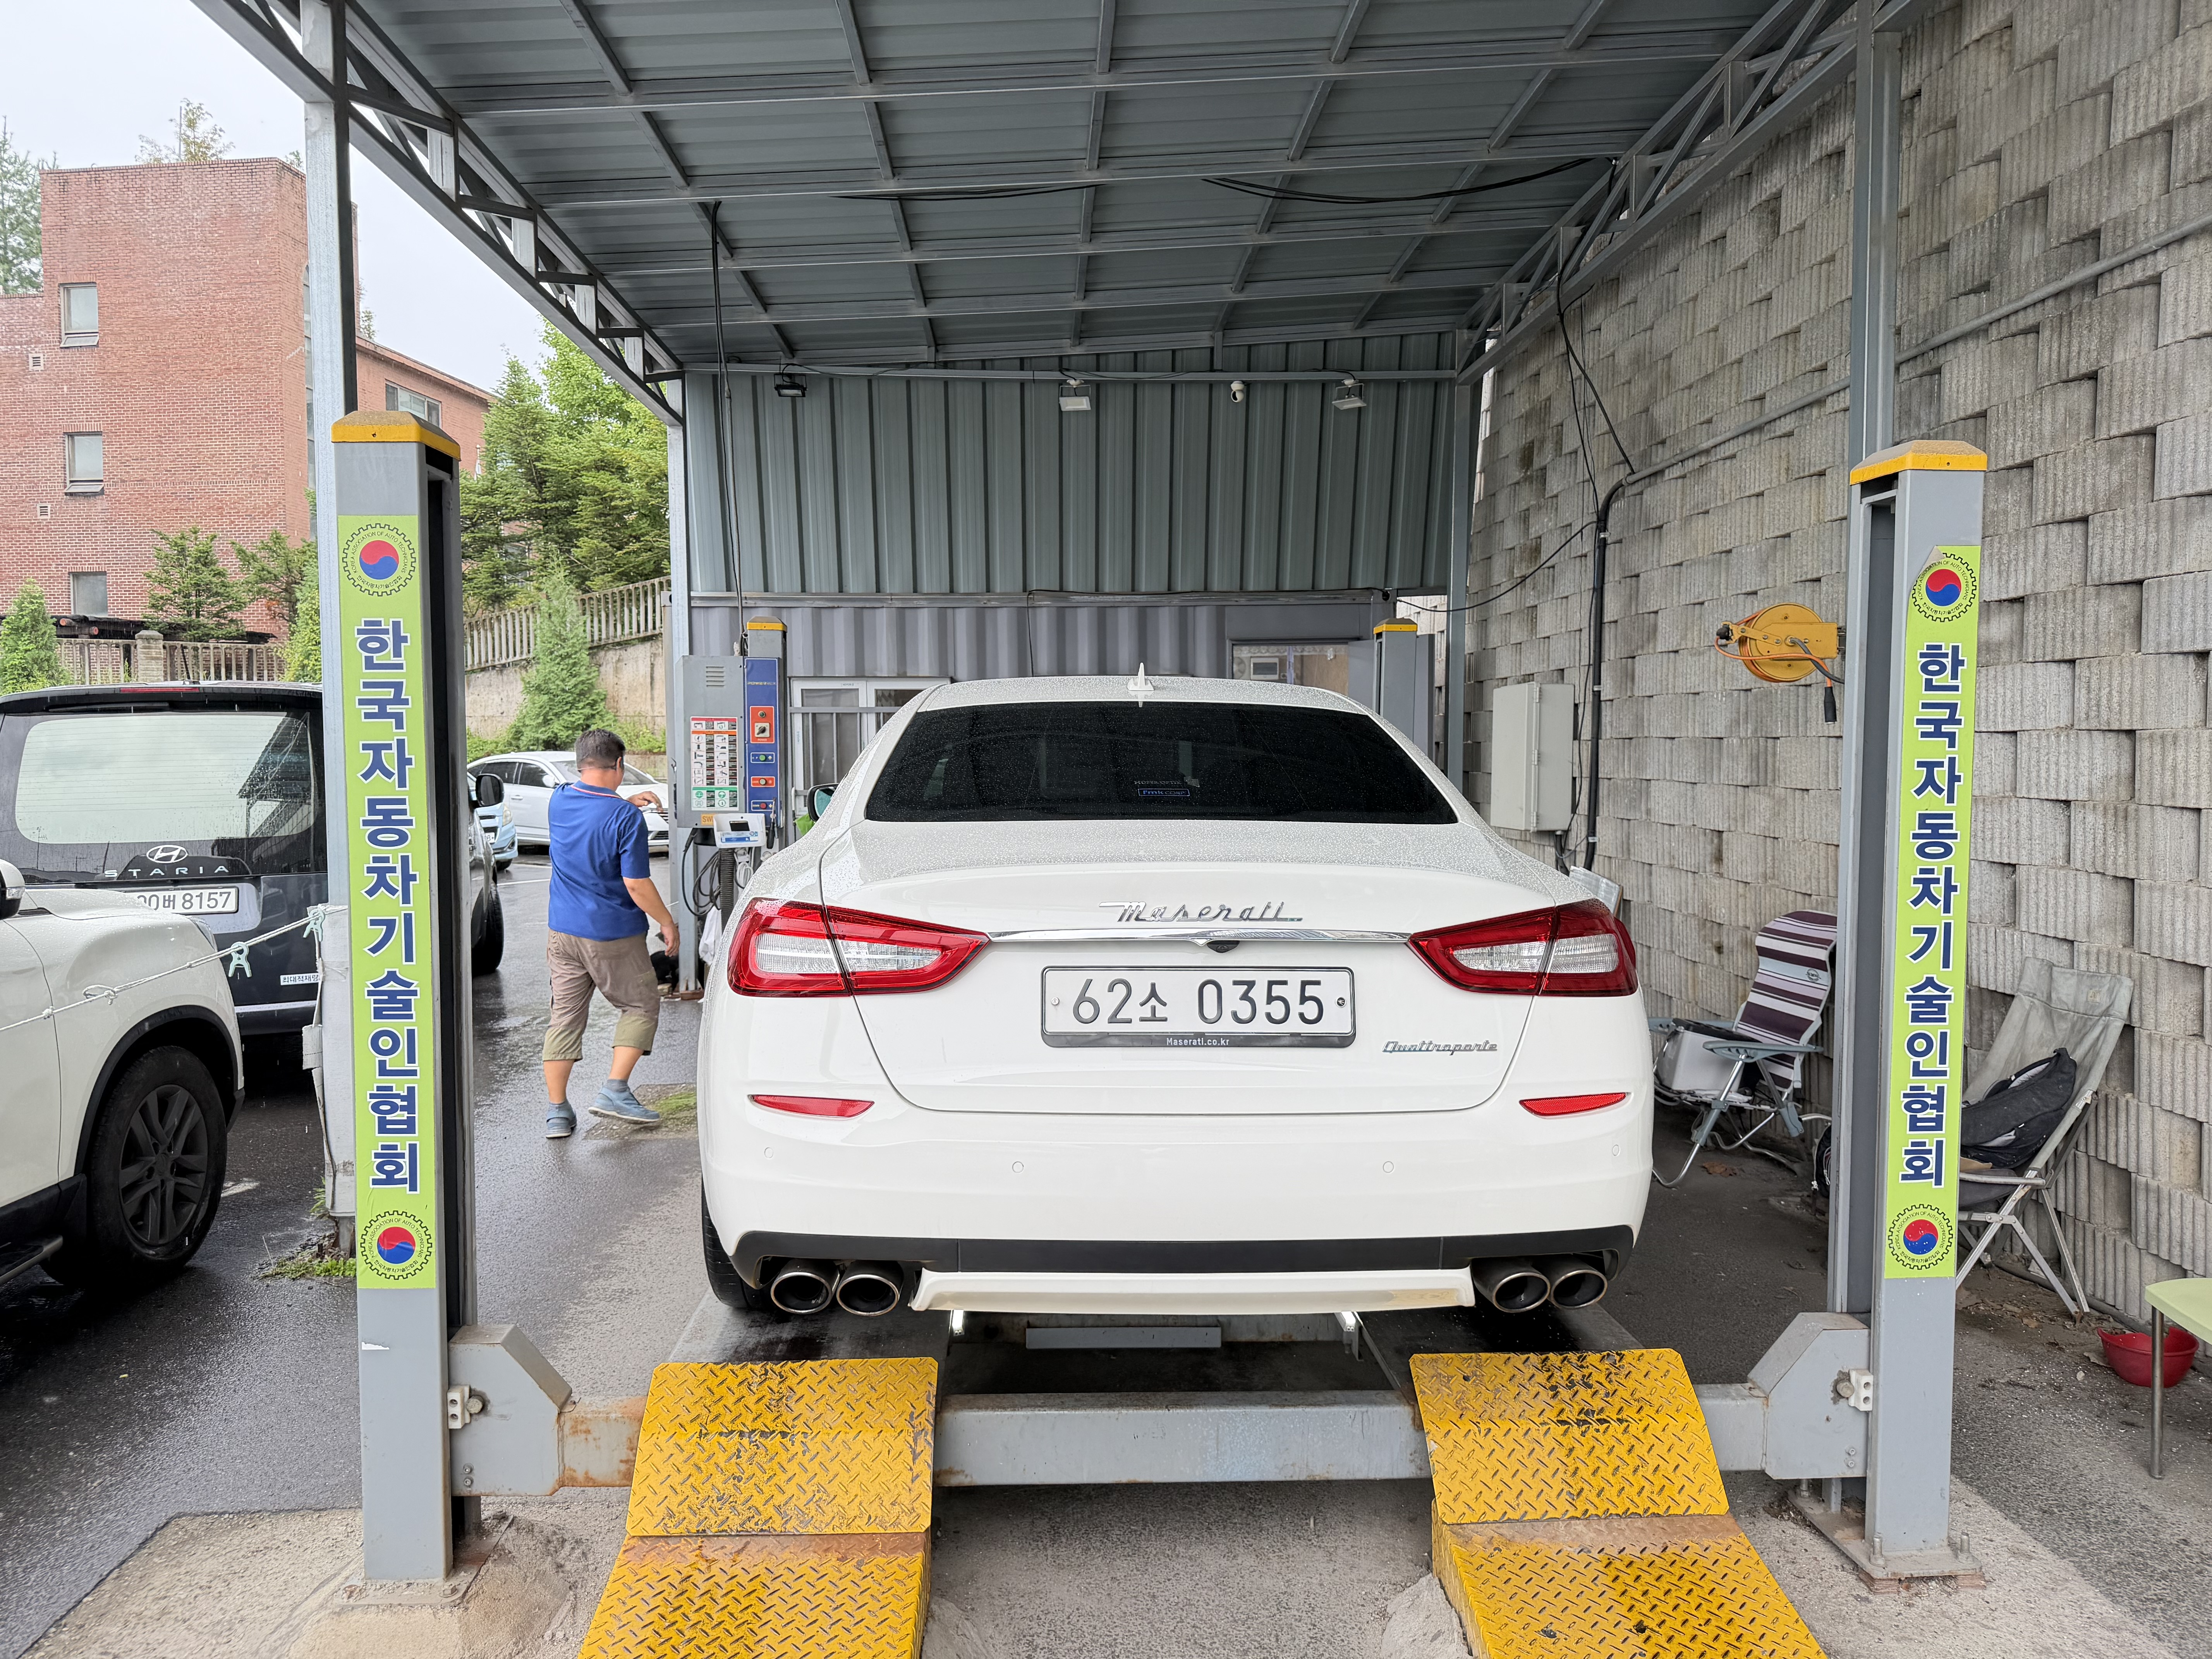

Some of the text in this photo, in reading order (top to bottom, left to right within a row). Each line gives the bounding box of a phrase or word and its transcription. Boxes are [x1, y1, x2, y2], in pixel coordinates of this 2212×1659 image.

[352, 532, 376, 555] ASSOCIATION
[385, 533, 398, 542] AUTO
[398, 541, 408, 573] TECHNICIANS
[1950, 562, 1961, 571] AUTO
[104, 866, 229, 877] STARIA
[182, 891, 231, 910] 8157
[356, 619, 419, 1194] 한국자동차기술인협회
[1099, 901, 1303, 922] Maserati
[1900, 643, 1966, 1188] 한국자동차기술인협회
[1073, 978, 1324, 1024] 62소 0355
[1166, 1037, 1230, 1046] Maserati.co.kr
[1382, 1040, 1498, 1056] Quattroporte
[1896, 1211, 1919, 1233] ASSOCIATION
[1927, 1213, 1939, 1221] AUTO
[370, 1218, 393, 1241] ASSOCIATION
[402, 1220, 415, 1229] AUTO
[414, 1228, 424, 1258] TECHNICIANS
